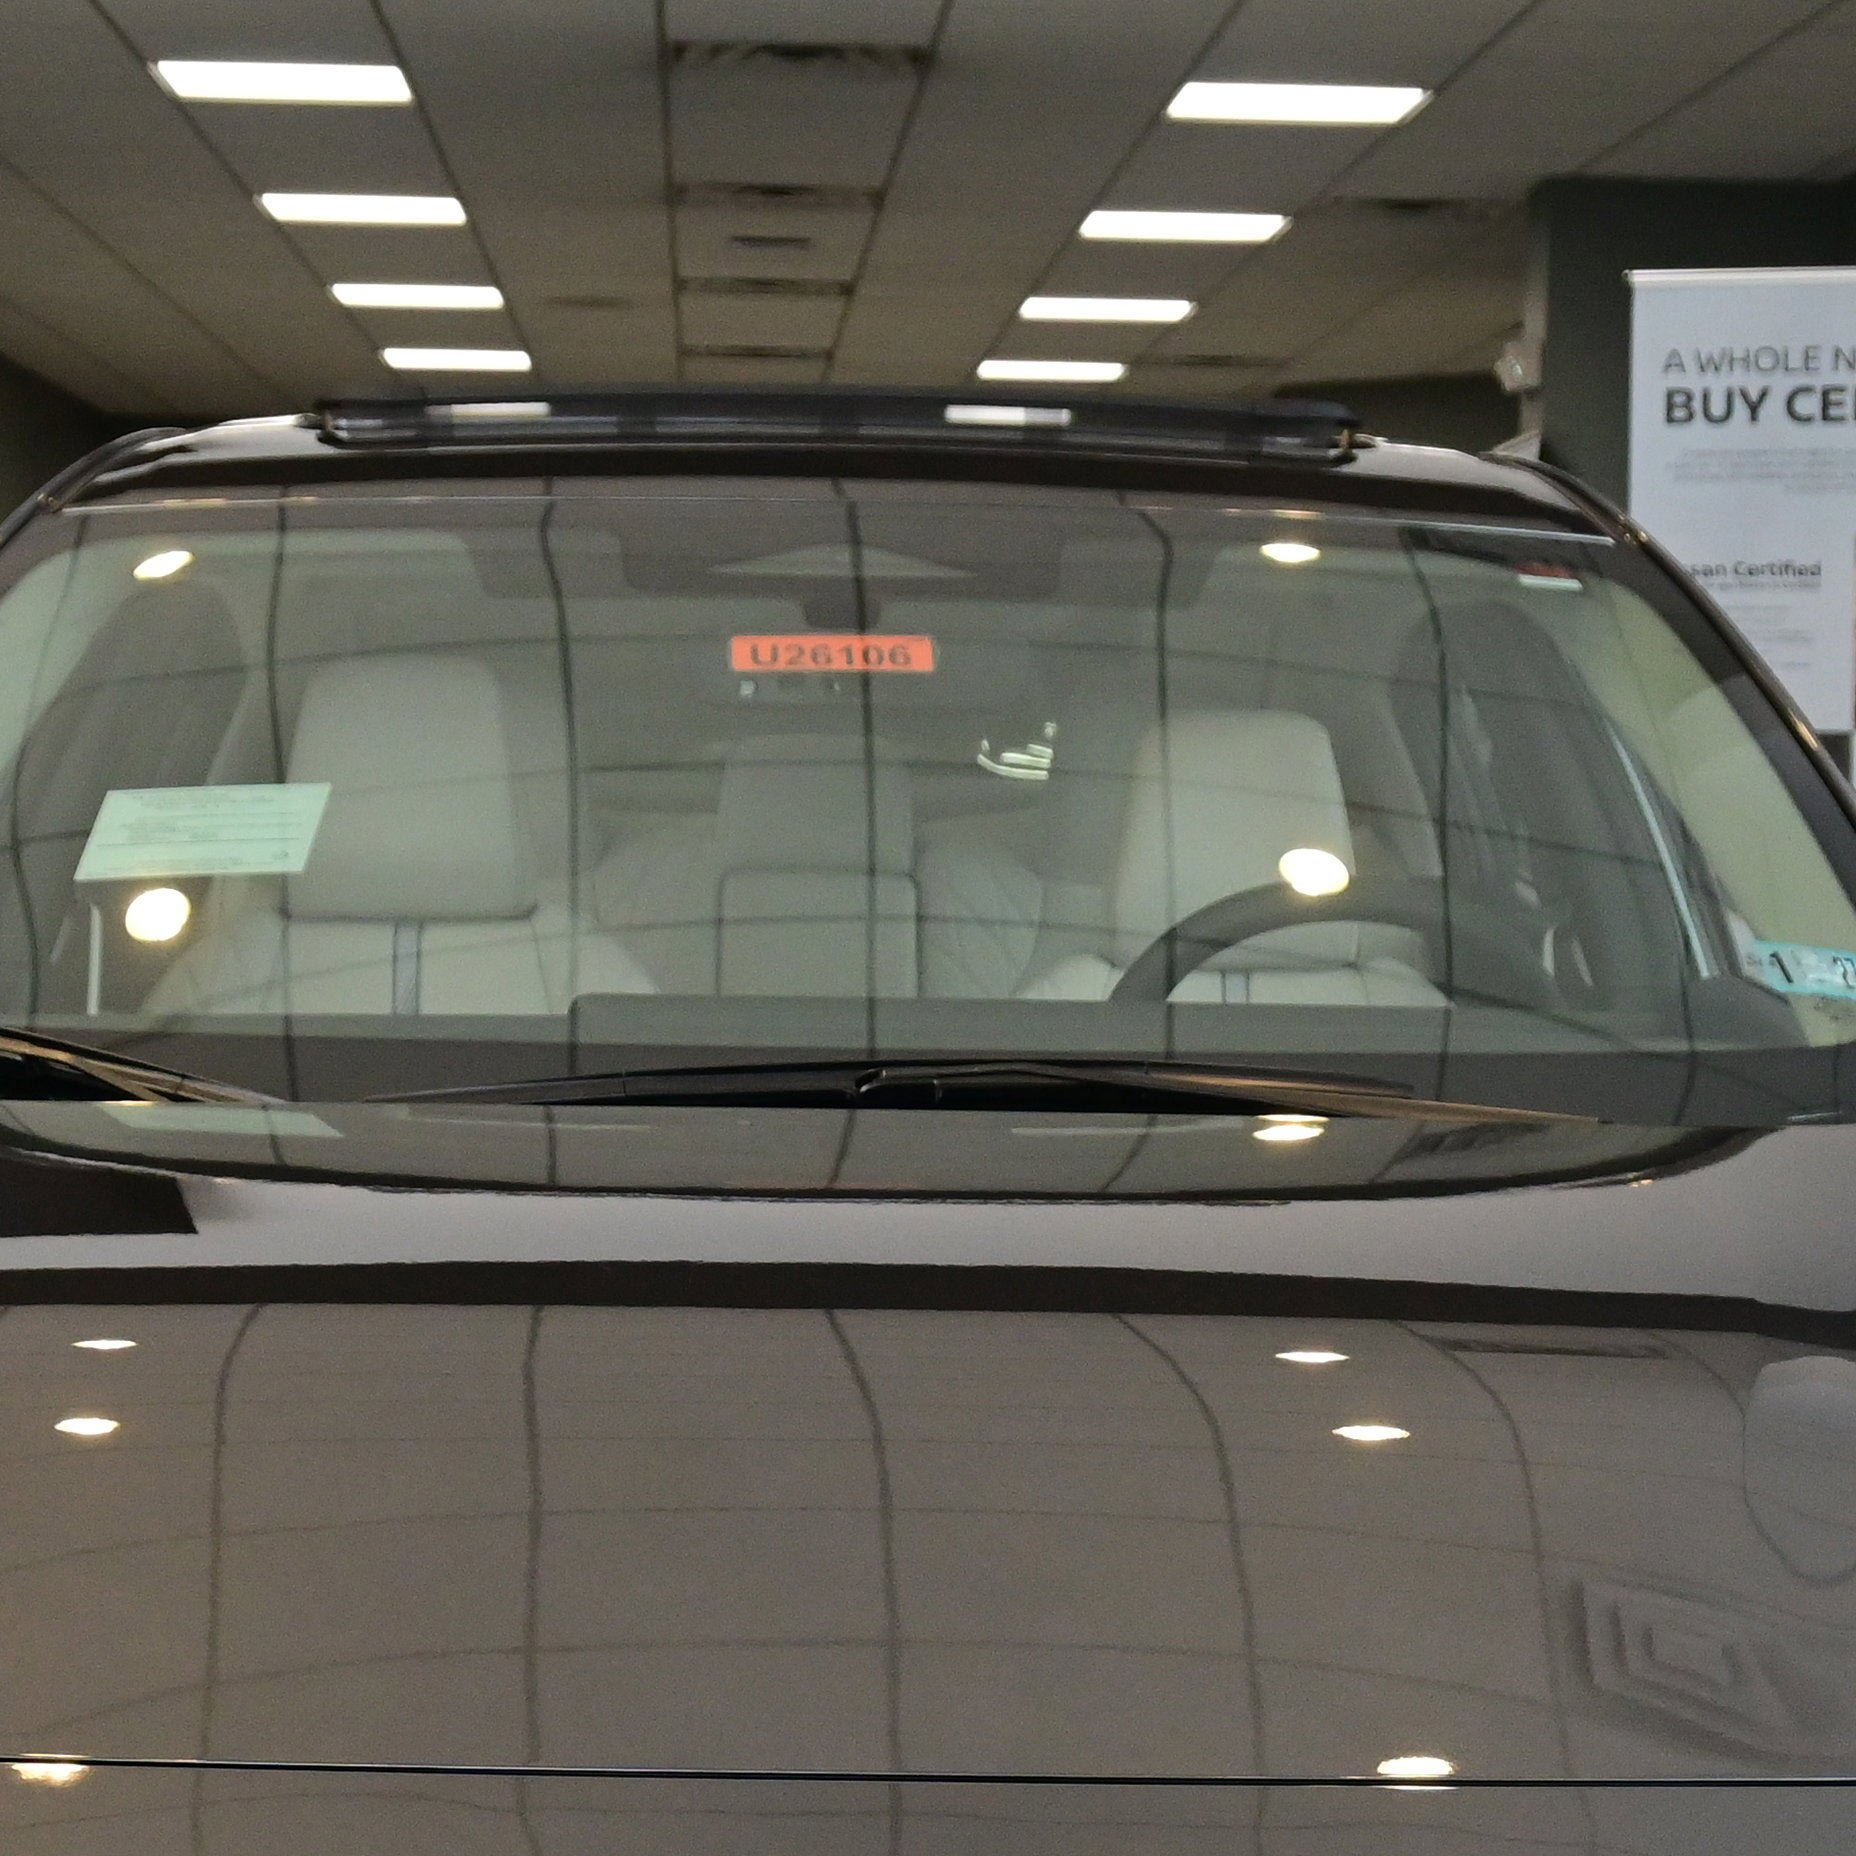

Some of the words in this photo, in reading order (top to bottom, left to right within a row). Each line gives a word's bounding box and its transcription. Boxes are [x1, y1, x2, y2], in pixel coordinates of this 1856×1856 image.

[1662, 347, 1687, 374] A
[1694, 344, 1822, 374] WHOLE
[1664, 384, 1771, 426] BUY
[1733, 560, 1823, 577] Certified
[749, 643, 913, 666] U26106
